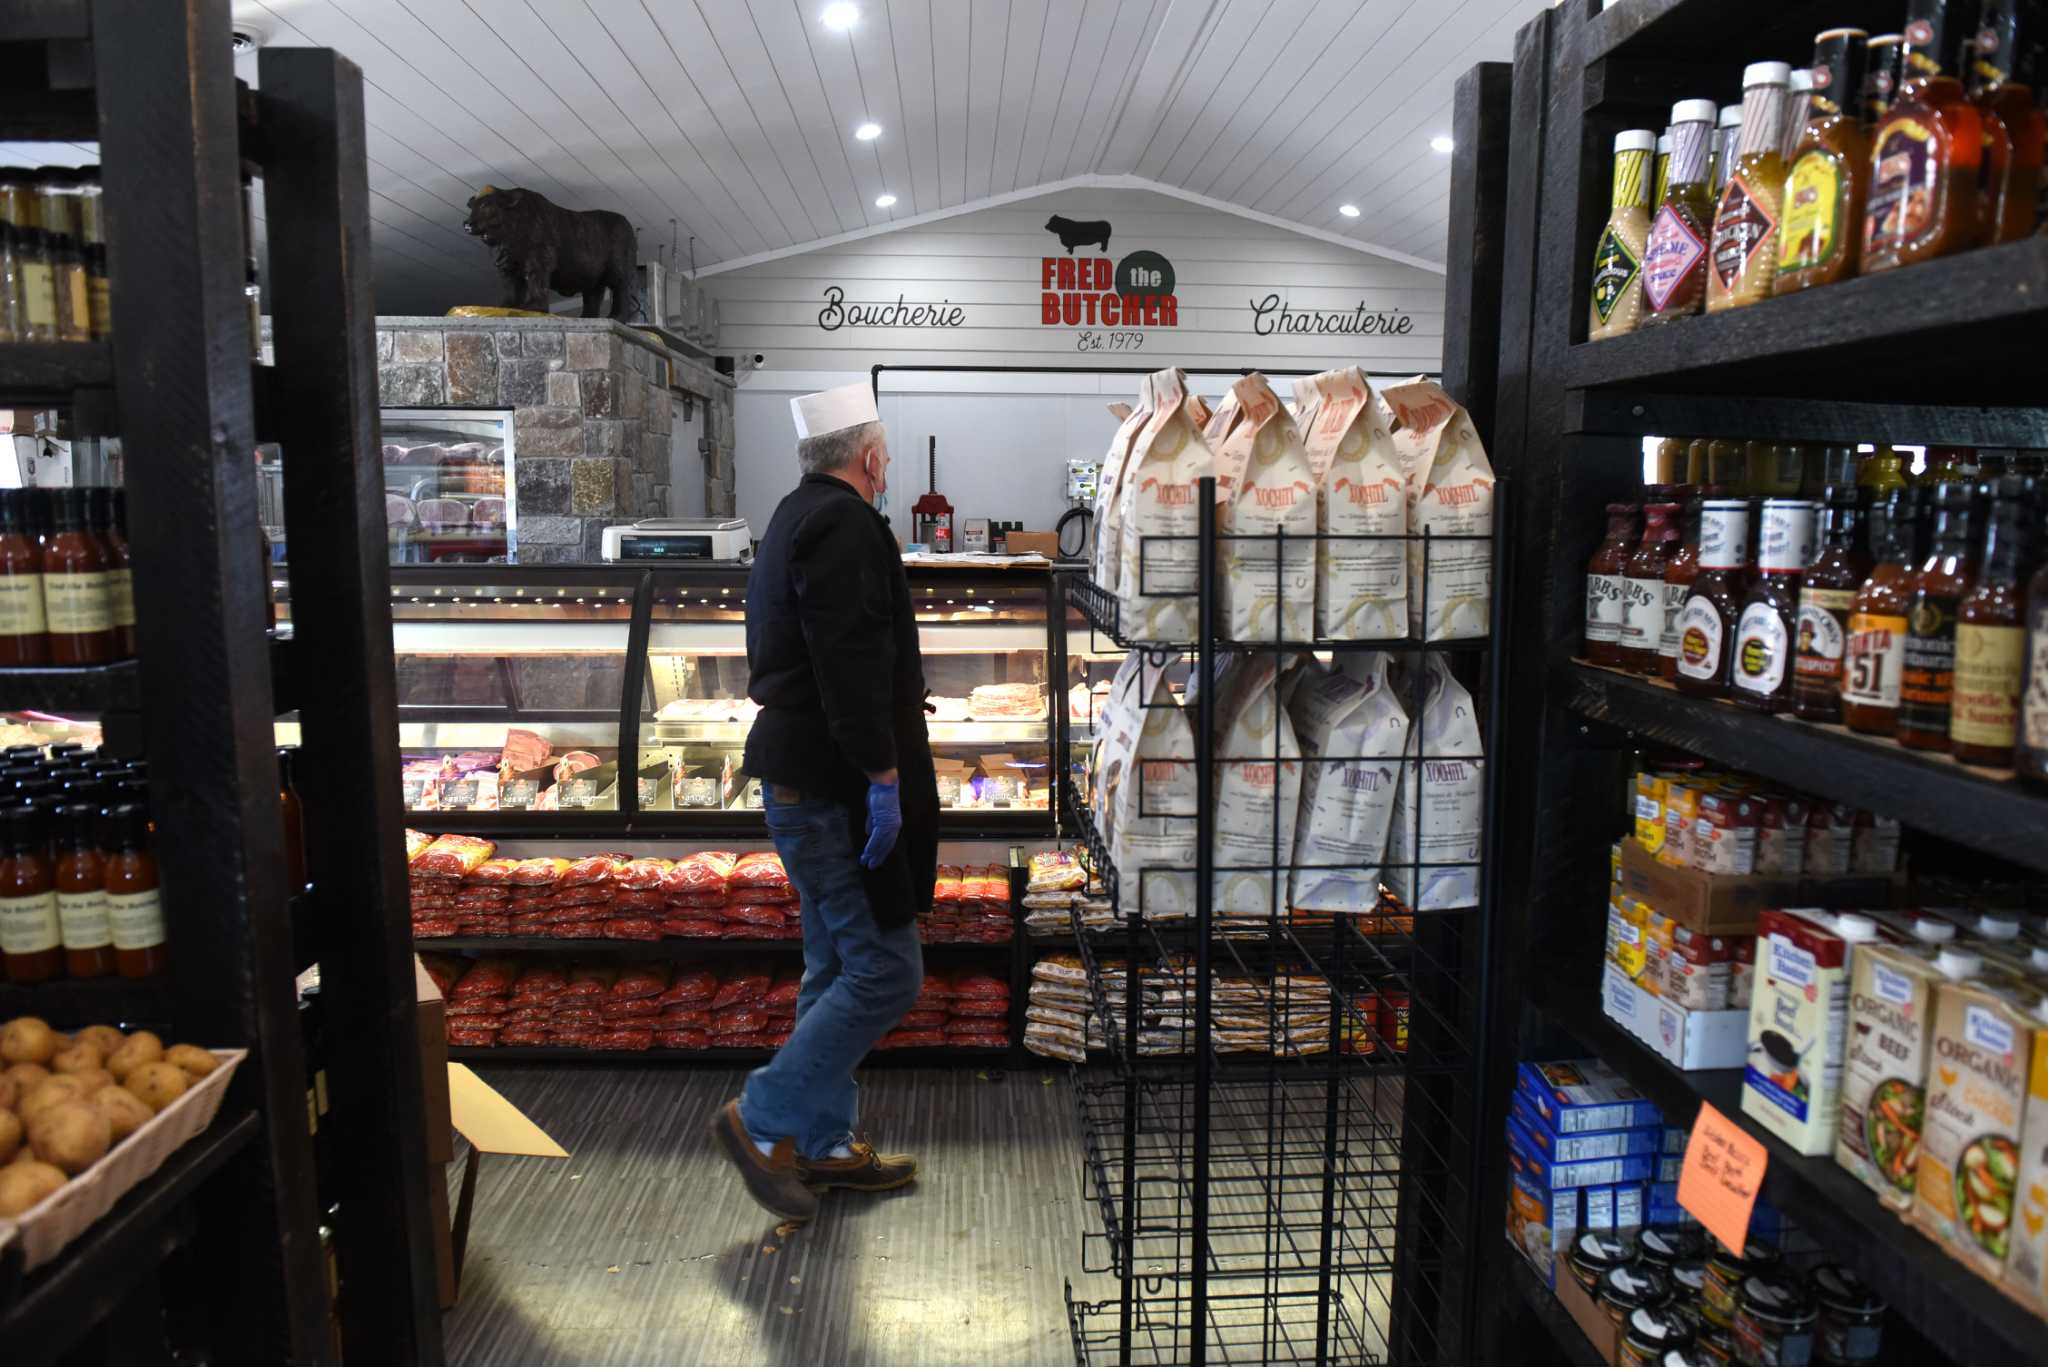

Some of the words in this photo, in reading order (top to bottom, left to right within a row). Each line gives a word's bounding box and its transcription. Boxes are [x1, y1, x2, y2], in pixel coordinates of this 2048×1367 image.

[1041, 257, 1113, 291] FRED
[1131, 266, 1162, 288] the
[818, 286, 966, 331] Boucherie
[1041, 293, 1178, 326] BUTCHER
[1249, 294, 1414, 336] Charcuterie
[1077, 331, 1105, 352] Est.
[1108, 331, 1144, 352] 1979
[1853, 653, 1883, 692] 51
[1879, 1033, 1911, 1061] BEEF
